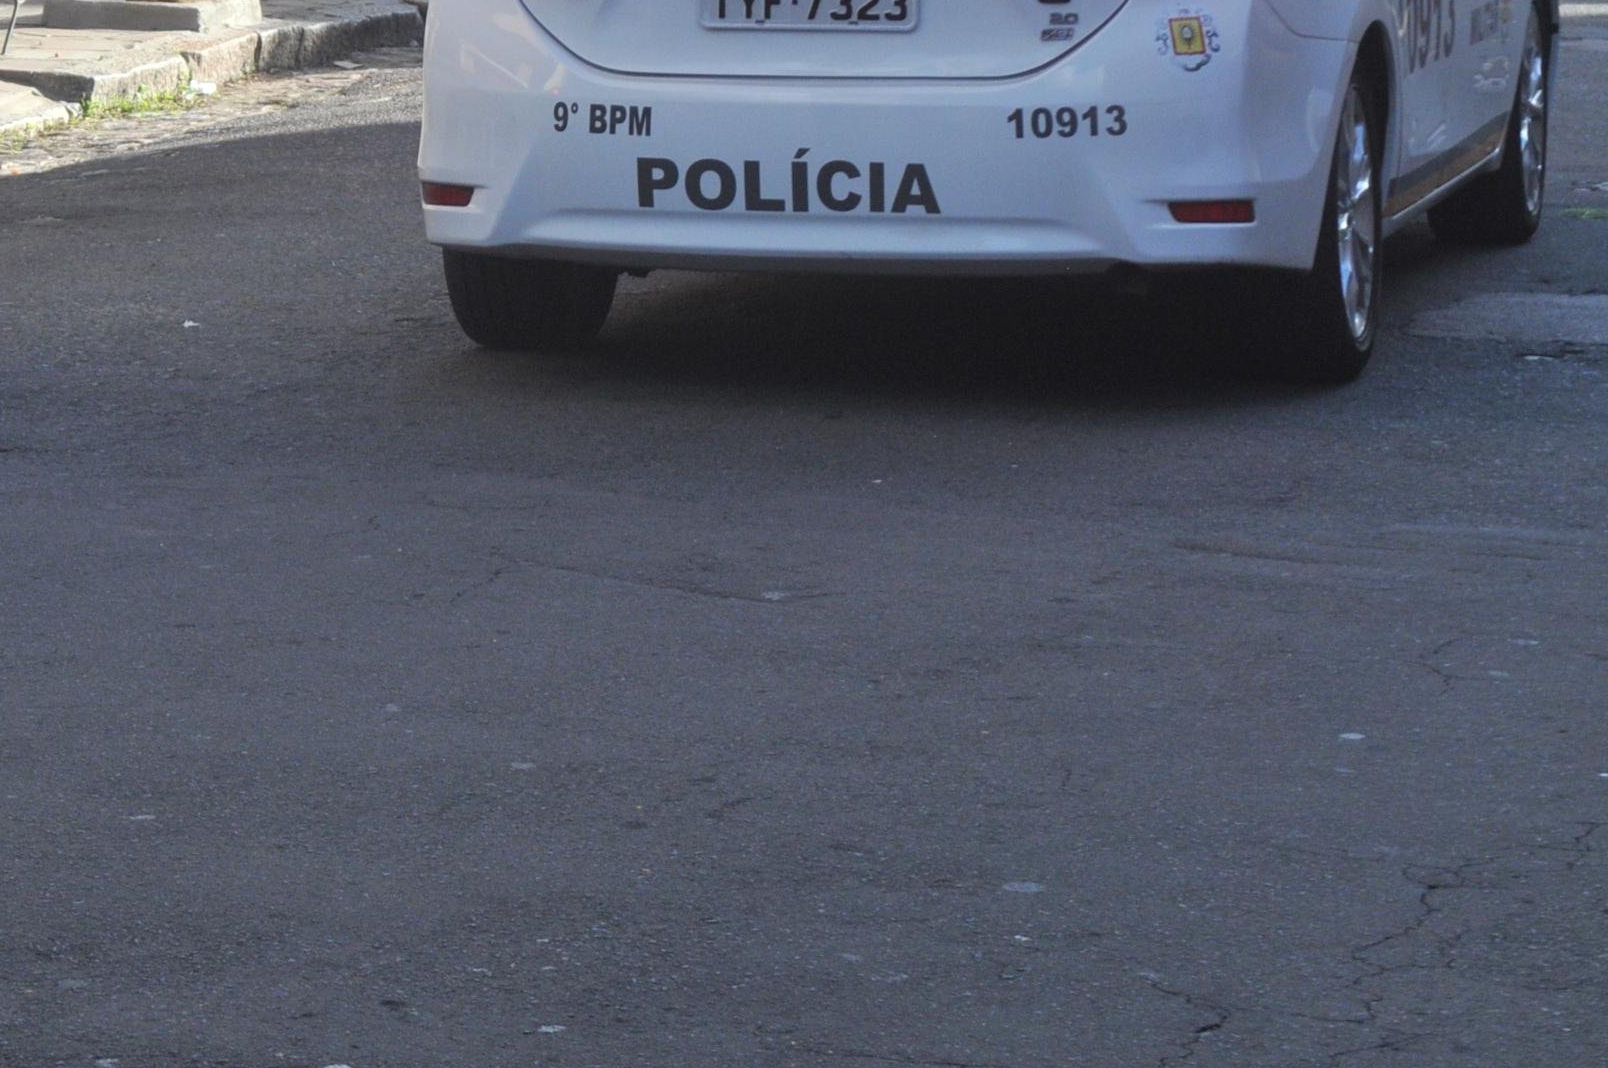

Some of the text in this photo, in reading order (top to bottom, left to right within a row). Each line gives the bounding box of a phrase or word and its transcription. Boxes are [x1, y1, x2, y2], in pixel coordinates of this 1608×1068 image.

[588, 104, 652, 136] BPM
[1006, 105, 1127, 138] 10913
[637, 148, 941, 214] POLÍCIA
